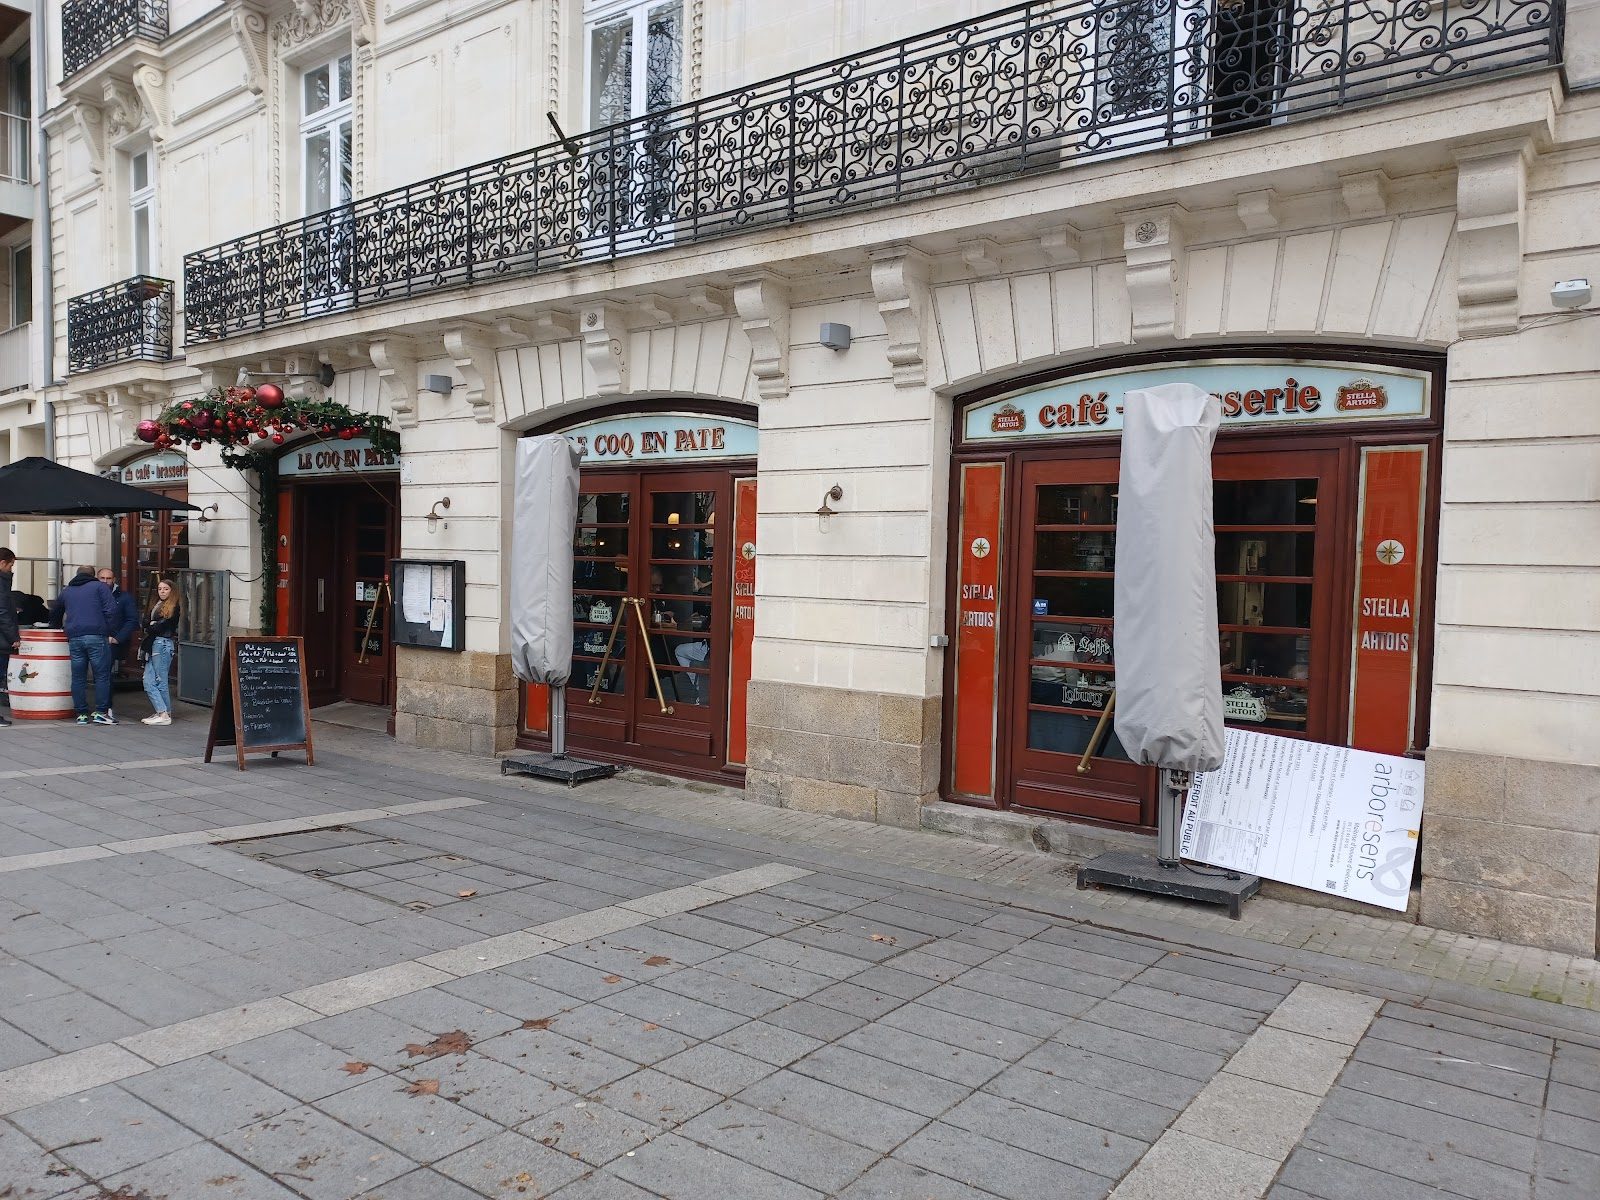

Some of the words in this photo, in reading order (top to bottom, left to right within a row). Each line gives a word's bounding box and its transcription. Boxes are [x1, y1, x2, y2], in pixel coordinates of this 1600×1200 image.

[1039, 392, 1110, 428] café
[1209, 377, 1321, 418] serie
[594, 432, 634, 458] COQ
[641, 431, 668, 453] EN
[674, 427, 725, 451] PATE
[297, 452, 312, 470] LE
[315, 451, 340, 470] COQ
[343, 448, 360, 467] EN
[135, 464, 150, 480] café
[735, 582, 754, 596] STELL
[962, 584, 994, 600] STELLA
[735, 606, 754, 620] ARTOI
[1362, 597, 1410, 618] STELLA
[962, 611, 994, 627] ARTOIS
[1077, 635, 1111, 657] Leffe
[1361, 630, 1410, 652] ARTOIS
[1225, 700, 1256, 709] STELLA
[1189, 771, 1204, 808] INTERDIT
[1187, 810, 1196, 822] AU
[1356, 762, 1397, 881] arboresens
[1180, 823, 1194, 855] PUBLIC
